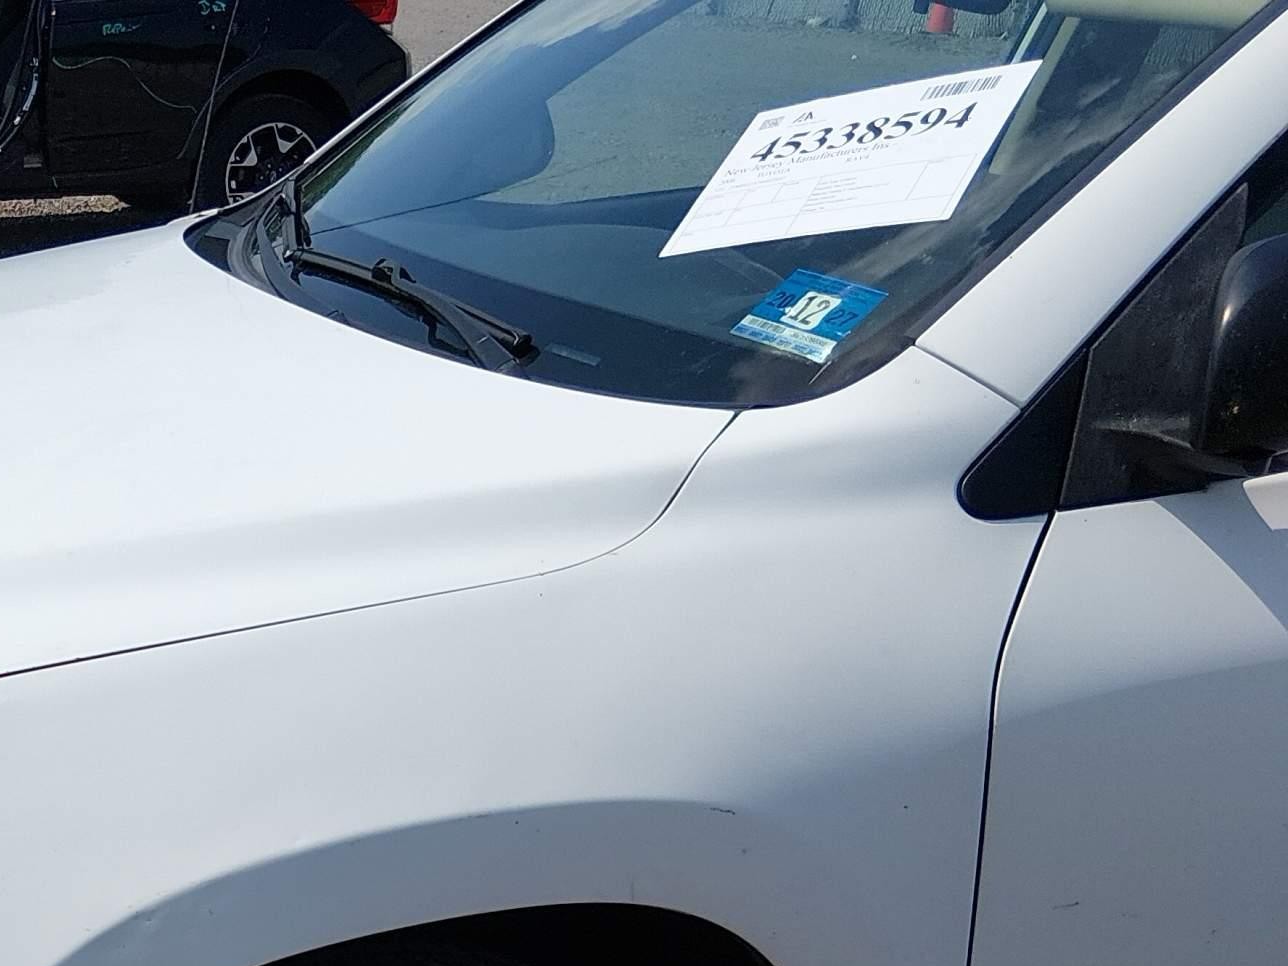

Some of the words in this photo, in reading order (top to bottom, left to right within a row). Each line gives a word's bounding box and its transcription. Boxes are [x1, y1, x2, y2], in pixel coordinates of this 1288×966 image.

[750, 101, 978, 162] 45338594
[769, 291, 792, 309] 20
[789, 295, 831, 326] 12
